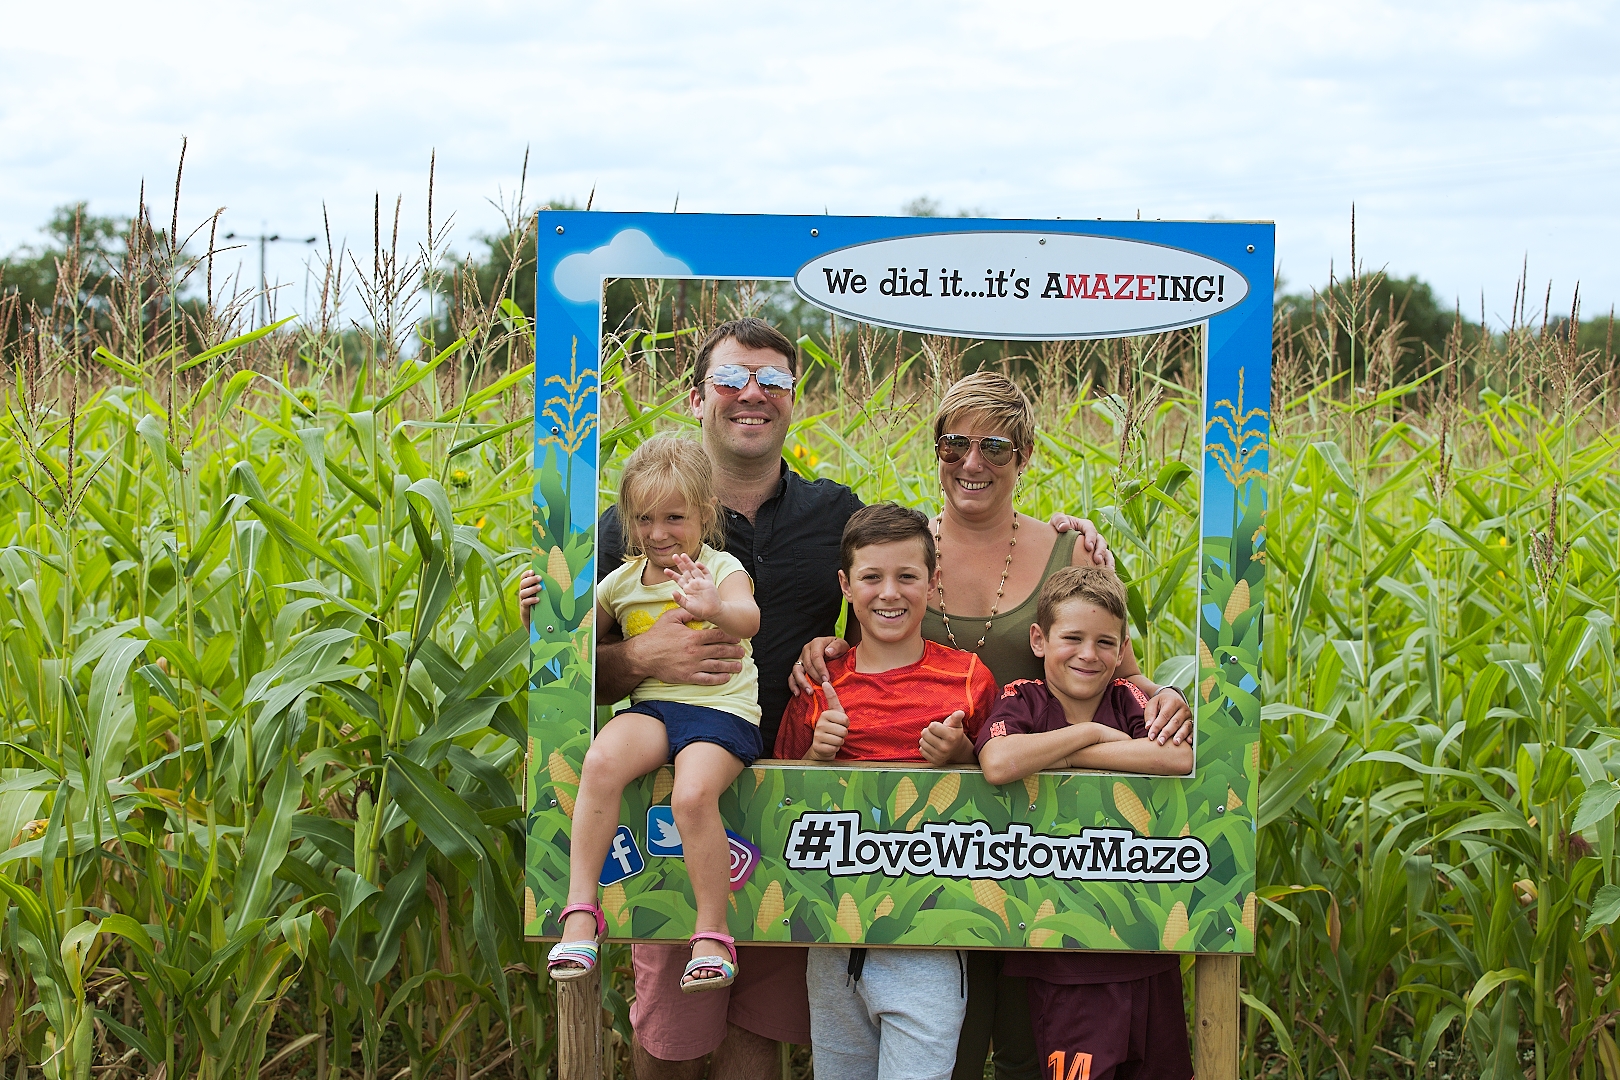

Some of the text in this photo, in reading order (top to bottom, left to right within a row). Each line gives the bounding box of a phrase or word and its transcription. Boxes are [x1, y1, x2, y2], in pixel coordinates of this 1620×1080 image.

[823, 268, 868, 294] We
[879, 268, 932, 297] did
[1041, 272, 1225, 303] AMAZEING!
[792, 818, 1202, 874] #loveWistowMaze
